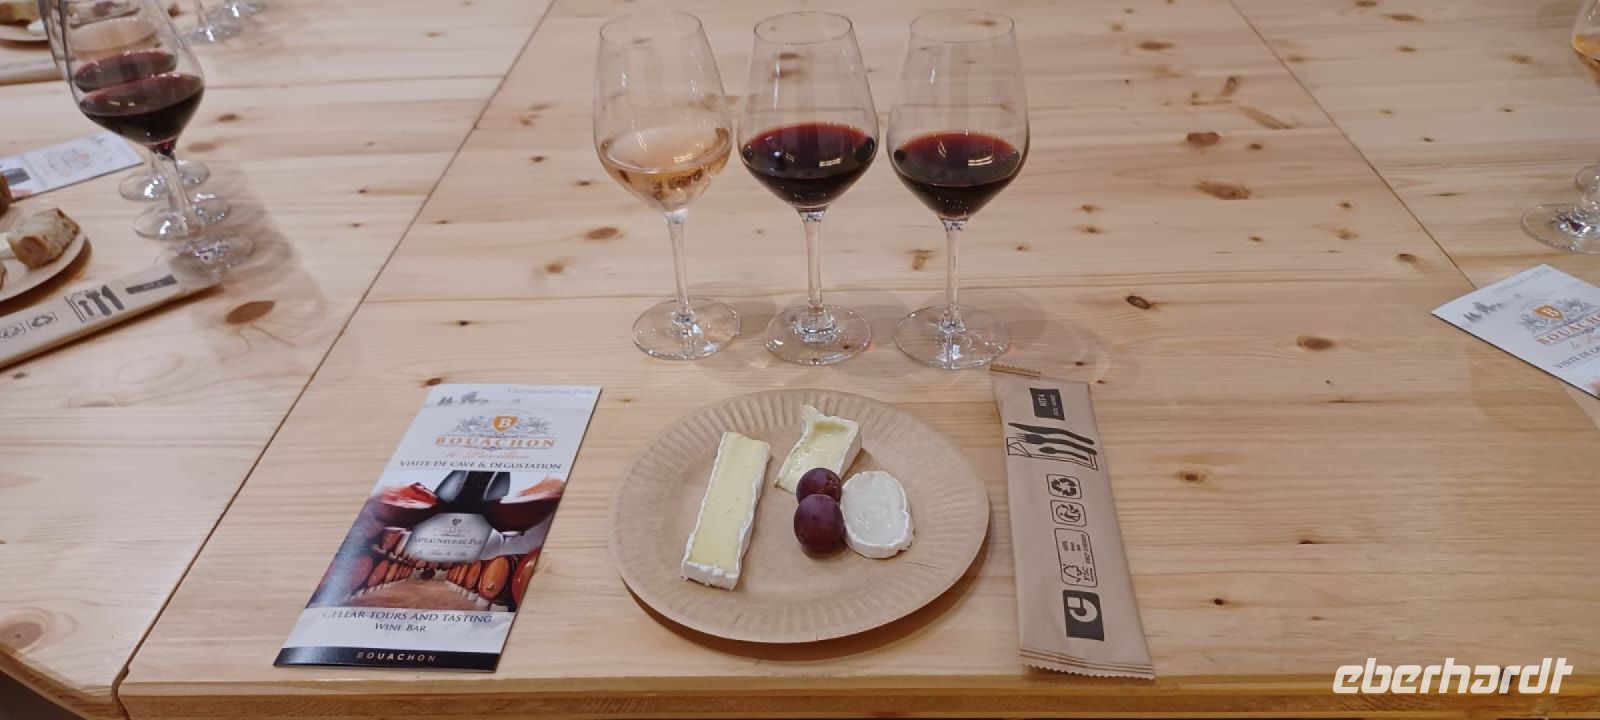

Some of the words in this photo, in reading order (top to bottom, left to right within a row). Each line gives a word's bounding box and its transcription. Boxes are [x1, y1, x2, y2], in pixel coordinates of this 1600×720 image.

[499, 417, 512, 428] B
[436, 436, 556, 448] BOUACHON
[321, 609, 365, 619] CELLAR
[369, 611, 408, 620] TOURS
[410, 613, 439, 621] AND
[442, 613, 493, 623] TASTING
[374, 622, 402, 631] WINE
[406, 624, 427, 632] BAR
[356, 651, 436, 662] BOUACHON
